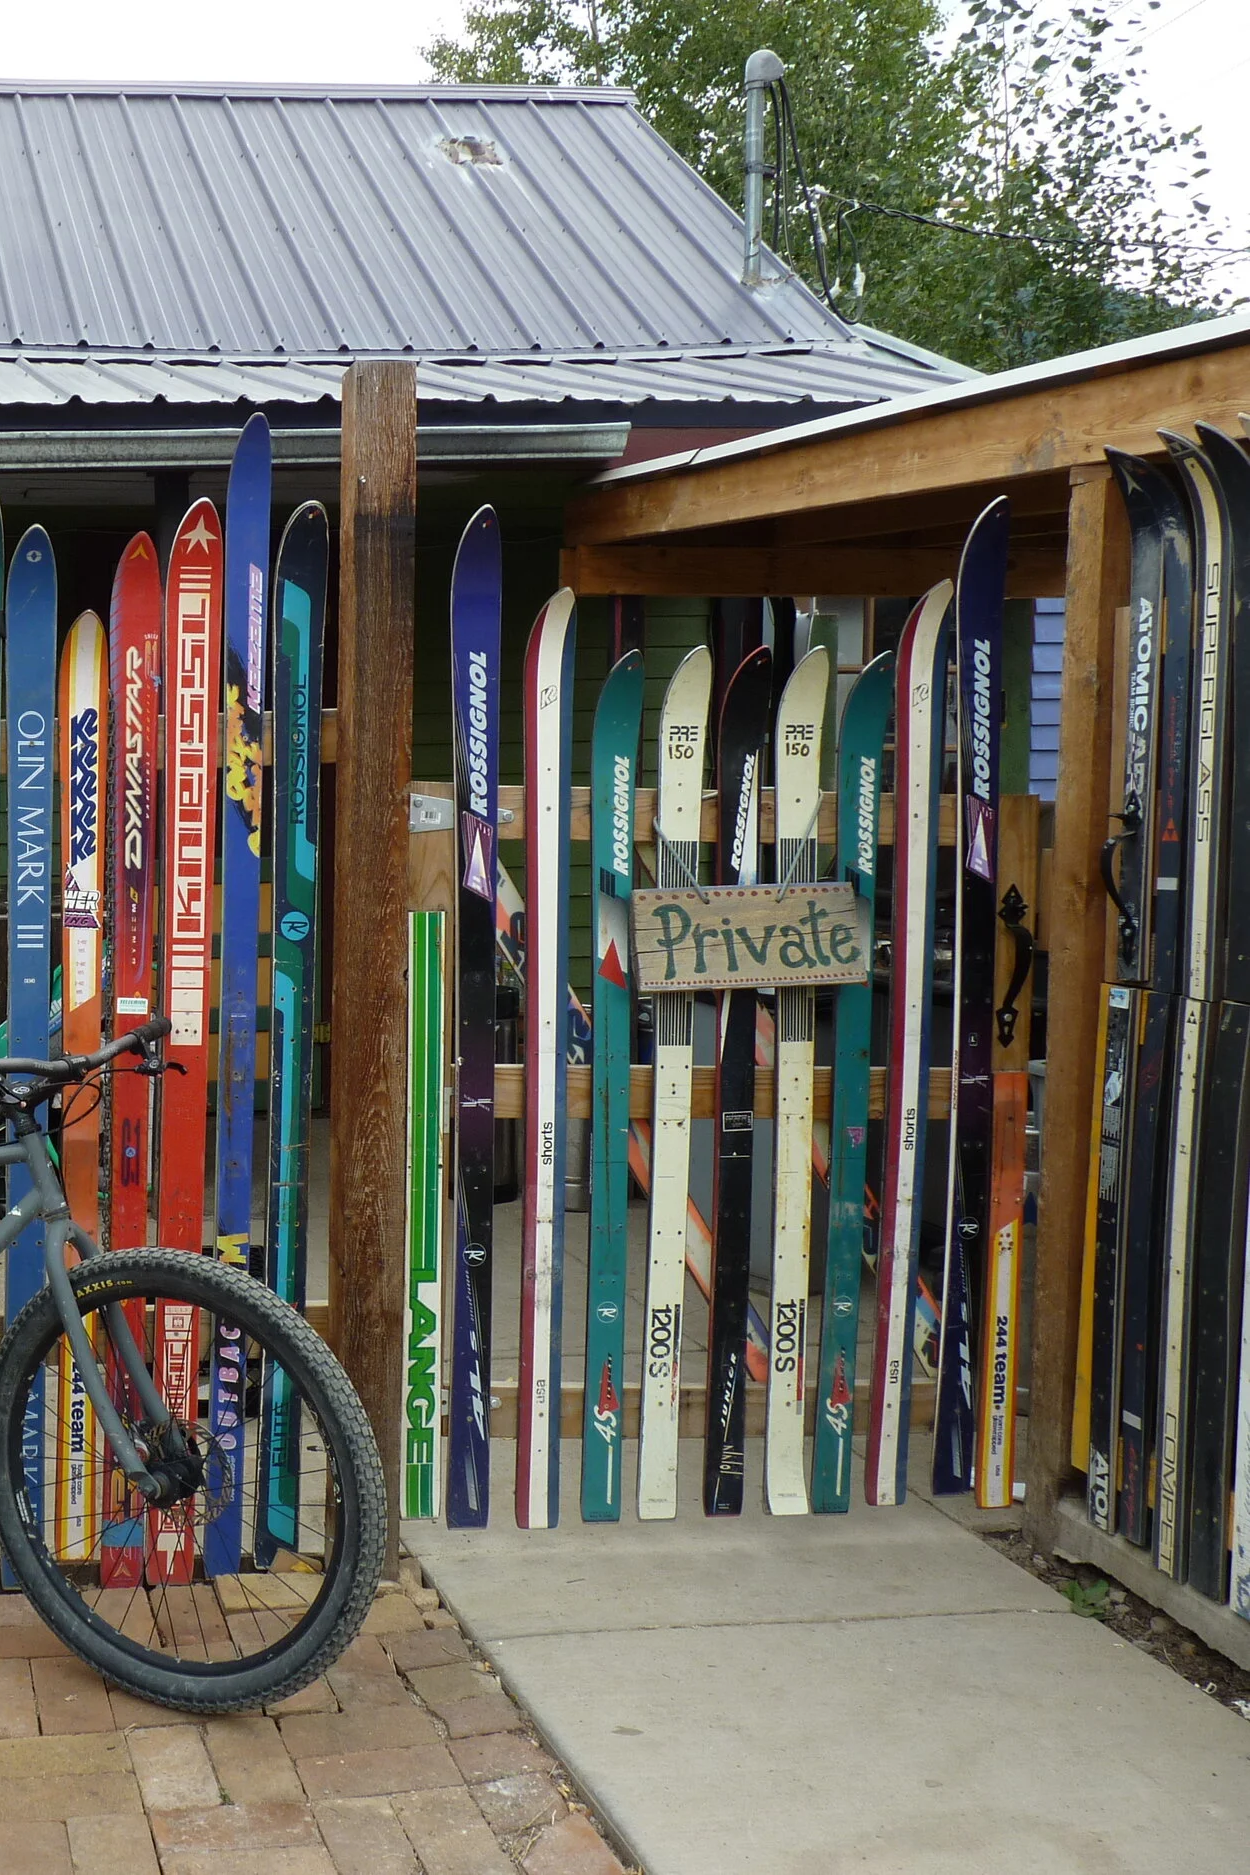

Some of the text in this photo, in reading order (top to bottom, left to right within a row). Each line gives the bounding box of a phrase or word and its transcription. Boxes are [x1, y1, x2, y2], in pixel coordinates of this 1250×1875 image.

[539, 685, 558, 710] K2
[1133, 597, 1155, 733] ATOMIC
[469, 651, 488, 817] ROSSIGNOL
[669, 725, 699, 741] PRE
[785, 725, 814, 740] PRE
[973, 638, 992, 801] ROSSIGNOL
[1197, 562, 1220, 844] SUPERGLASS
[125, 645, 144, 870] DYNASTAR
[290, 674, 307, 826] ROSSIGNOL
[669, 743, 695, 760] 150
[785, 742, 810, 757] 150
[16, 710, 45, 949] OLIN MARK III
[613, 755, 631, 877] ROSSIGNOL
[731, 753, 756, 871] ROSSIGNOL
[857, 756, 876, 875] ROSSIGNOL
[65, 890, 100, 910] WER
[651, 900, 861, 981] Private
[541, 1121, 553, 1165] shorts
[904, 1108, 916, 1151] shorts
[650, 1304, 672, 1359] 1200
[776, 1299, 796, 1353] 1200
[217, 1322, 242, 1450] OUTBAC
[406, 1268, 437, 1465] LANGE
[536, 1379, 546, 1404] usa
[721, 1352, 737, 1428] JUNIOR
[890, 1360, 900, 1384] usa
[993, 1315, 1009, 1405] 244 team
[69, 1399, 85, 1453] team
[593, 1405, 617, 1444] 4S
[826, 1398, 849, 1436] 4S
